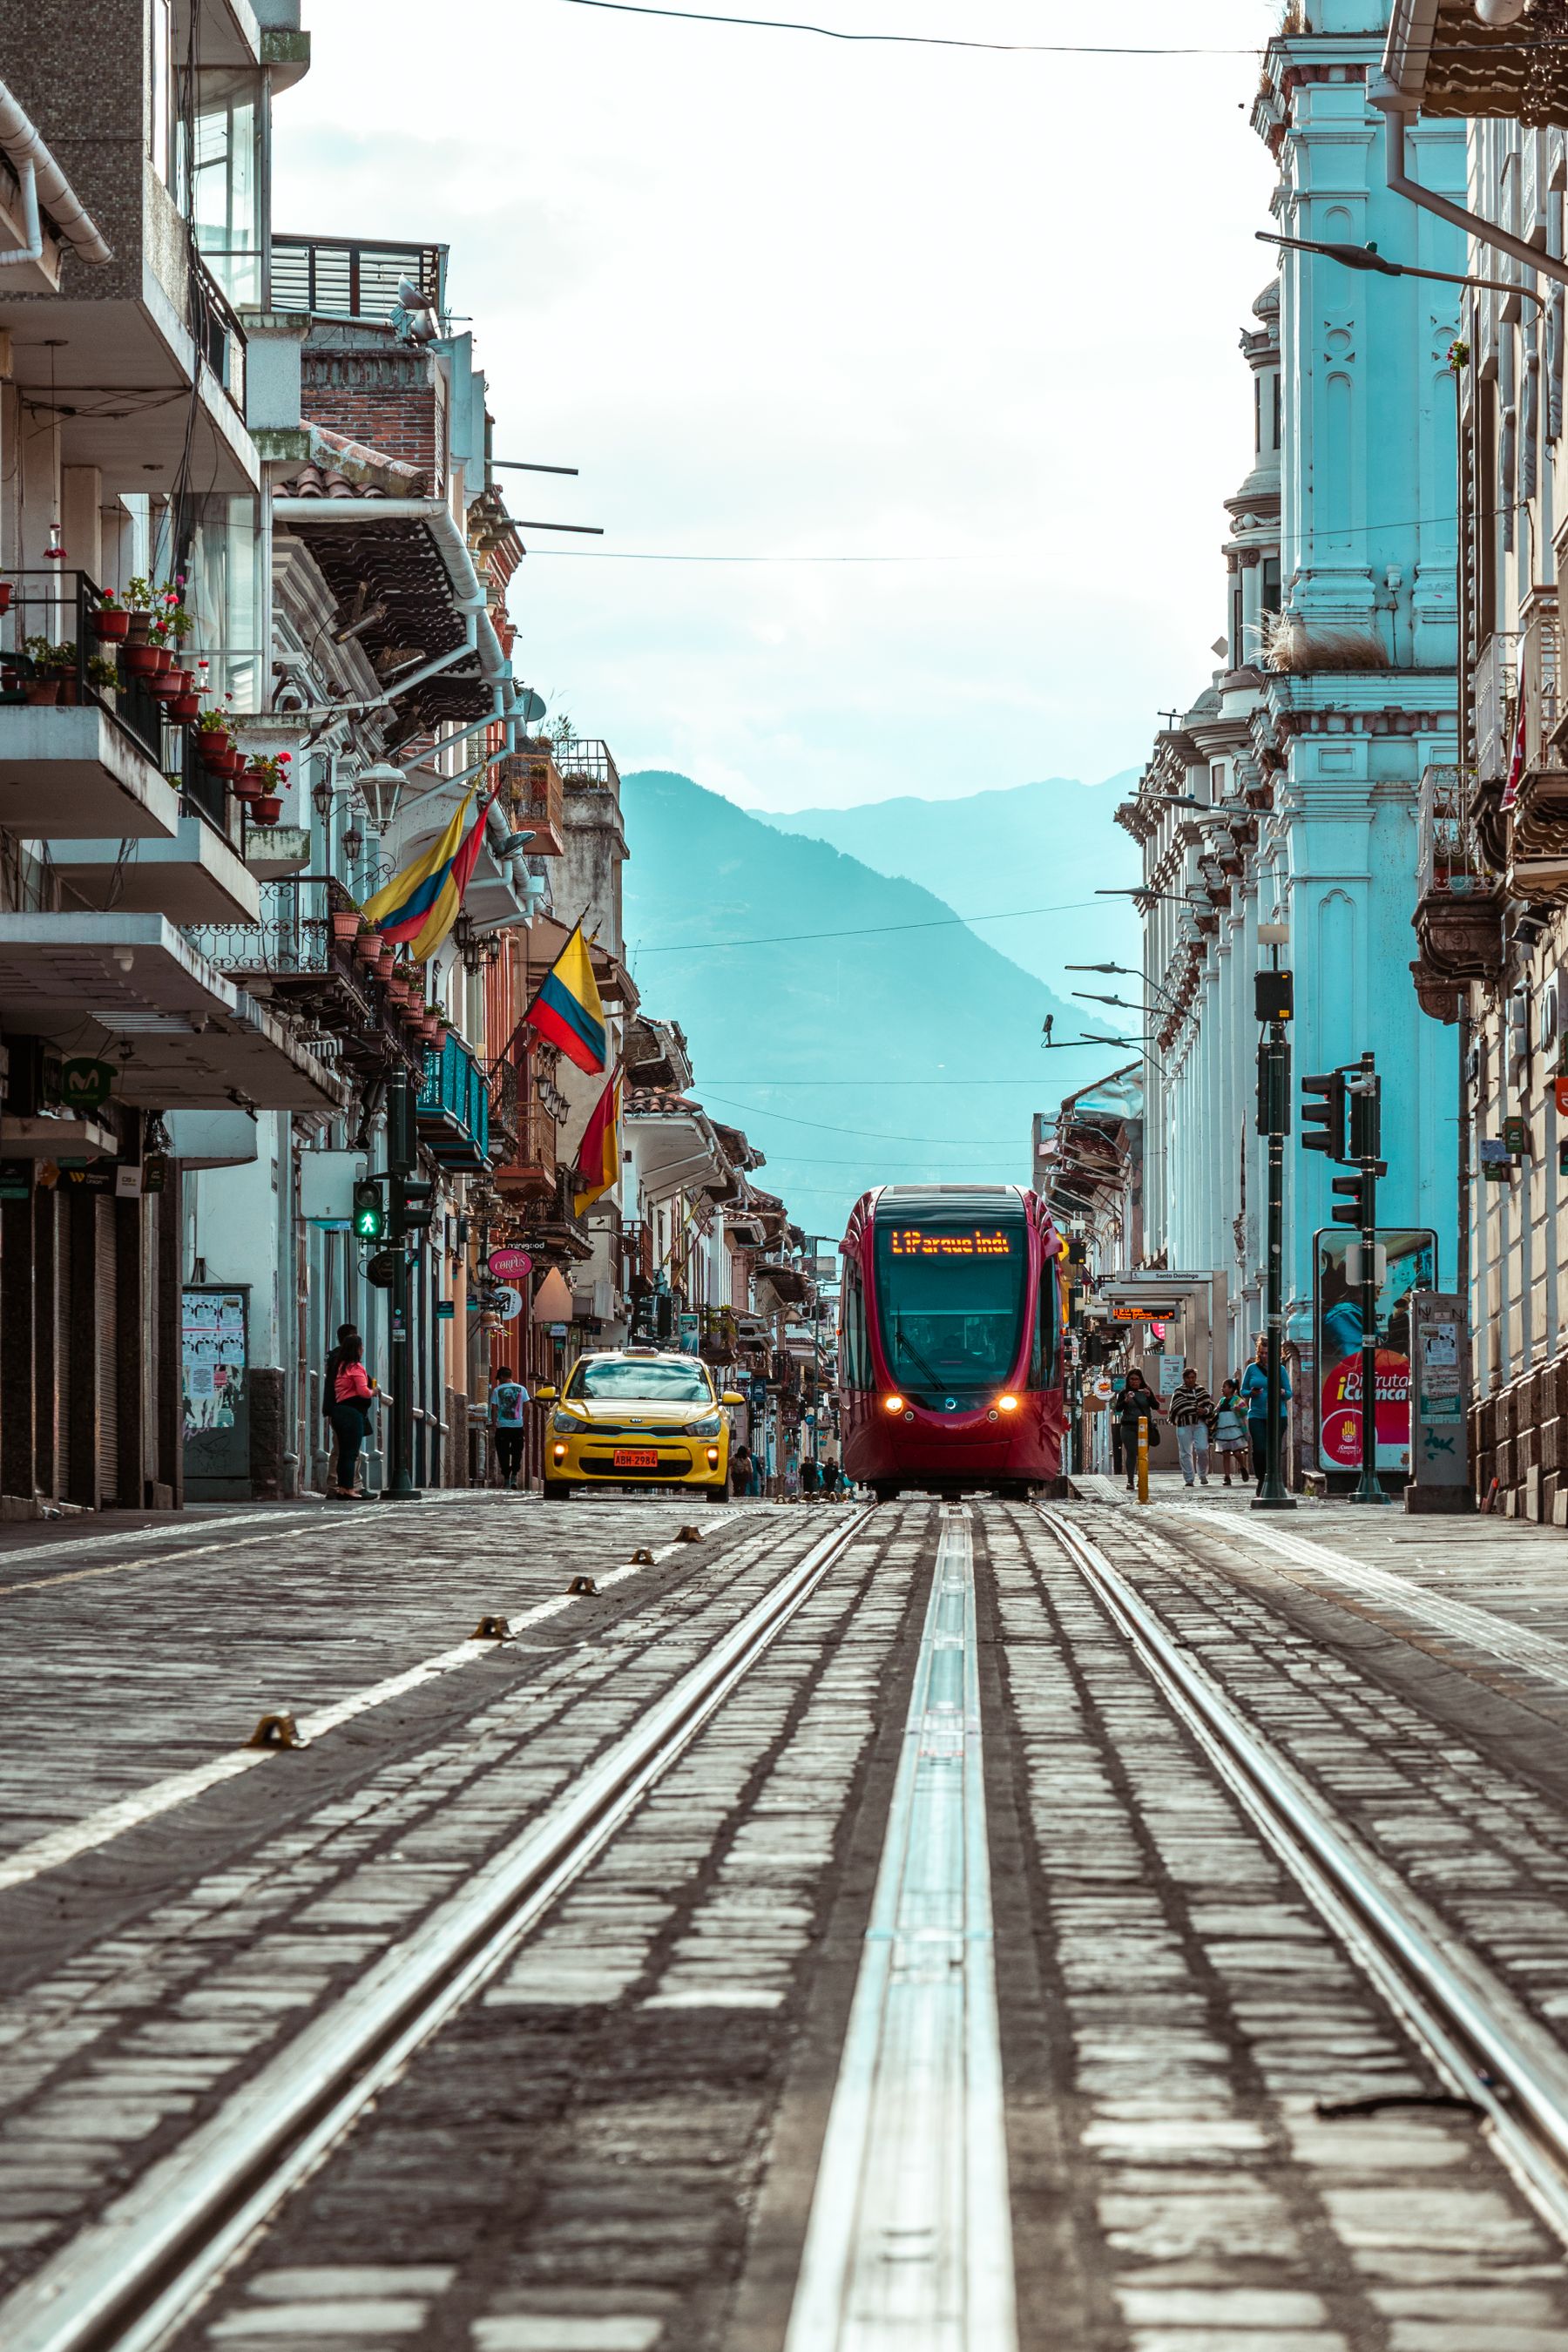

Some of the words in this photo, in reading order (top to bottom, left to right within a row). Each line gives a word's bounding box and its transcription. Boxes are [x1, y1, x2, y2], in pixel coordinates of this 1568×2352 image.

[287, 1016, 321, 1033] hotel
[495, 1254, 525, 1273] CORPUS
[1336, 1376, 1407, 1400] ¡Cunca
[1347, 1372, 1409, 1388] Diruta
[615, 1456, 656, 1465] ABH-2984
